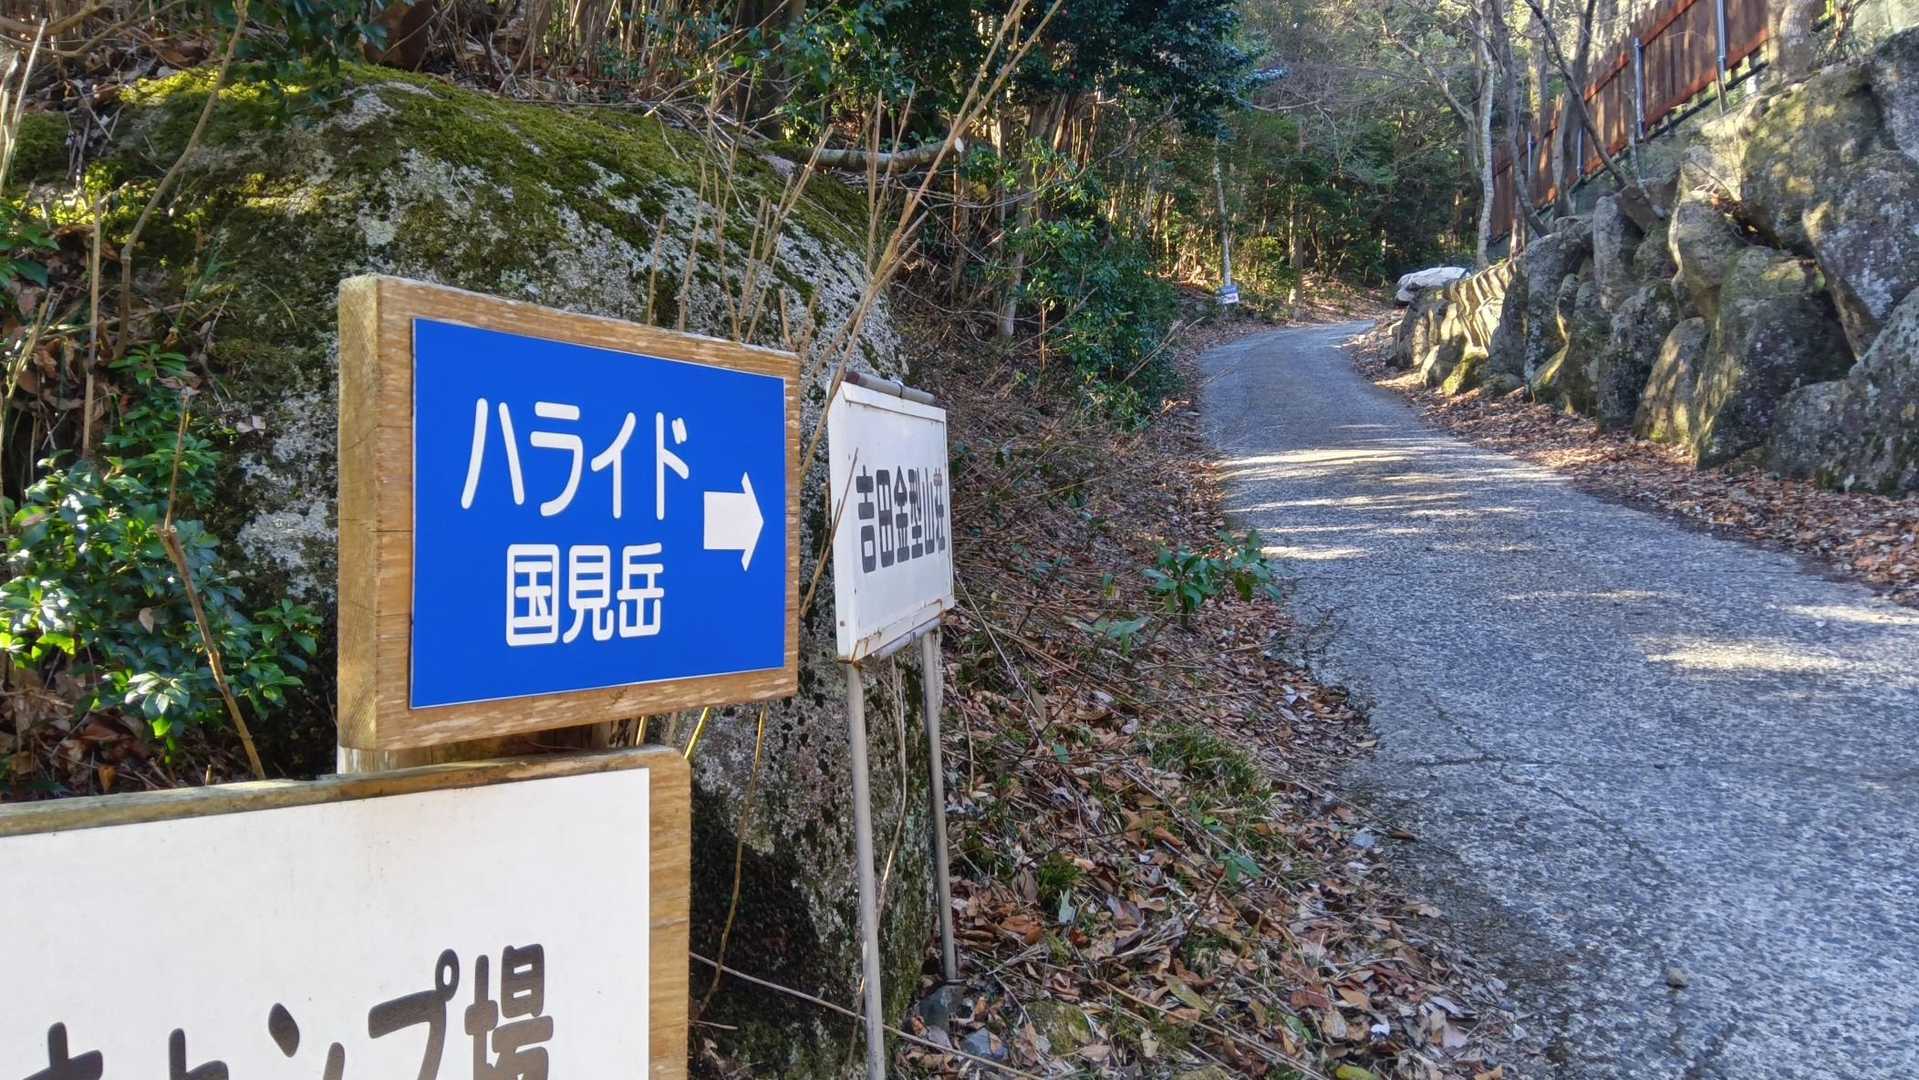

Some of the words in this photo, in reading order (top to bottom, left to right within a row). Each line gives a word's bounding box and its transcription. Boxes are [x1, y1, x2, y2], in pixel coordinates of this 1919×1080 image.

[460, 397, 690, 520] ハライド
[505, 541, 665, 647] 国見岳
